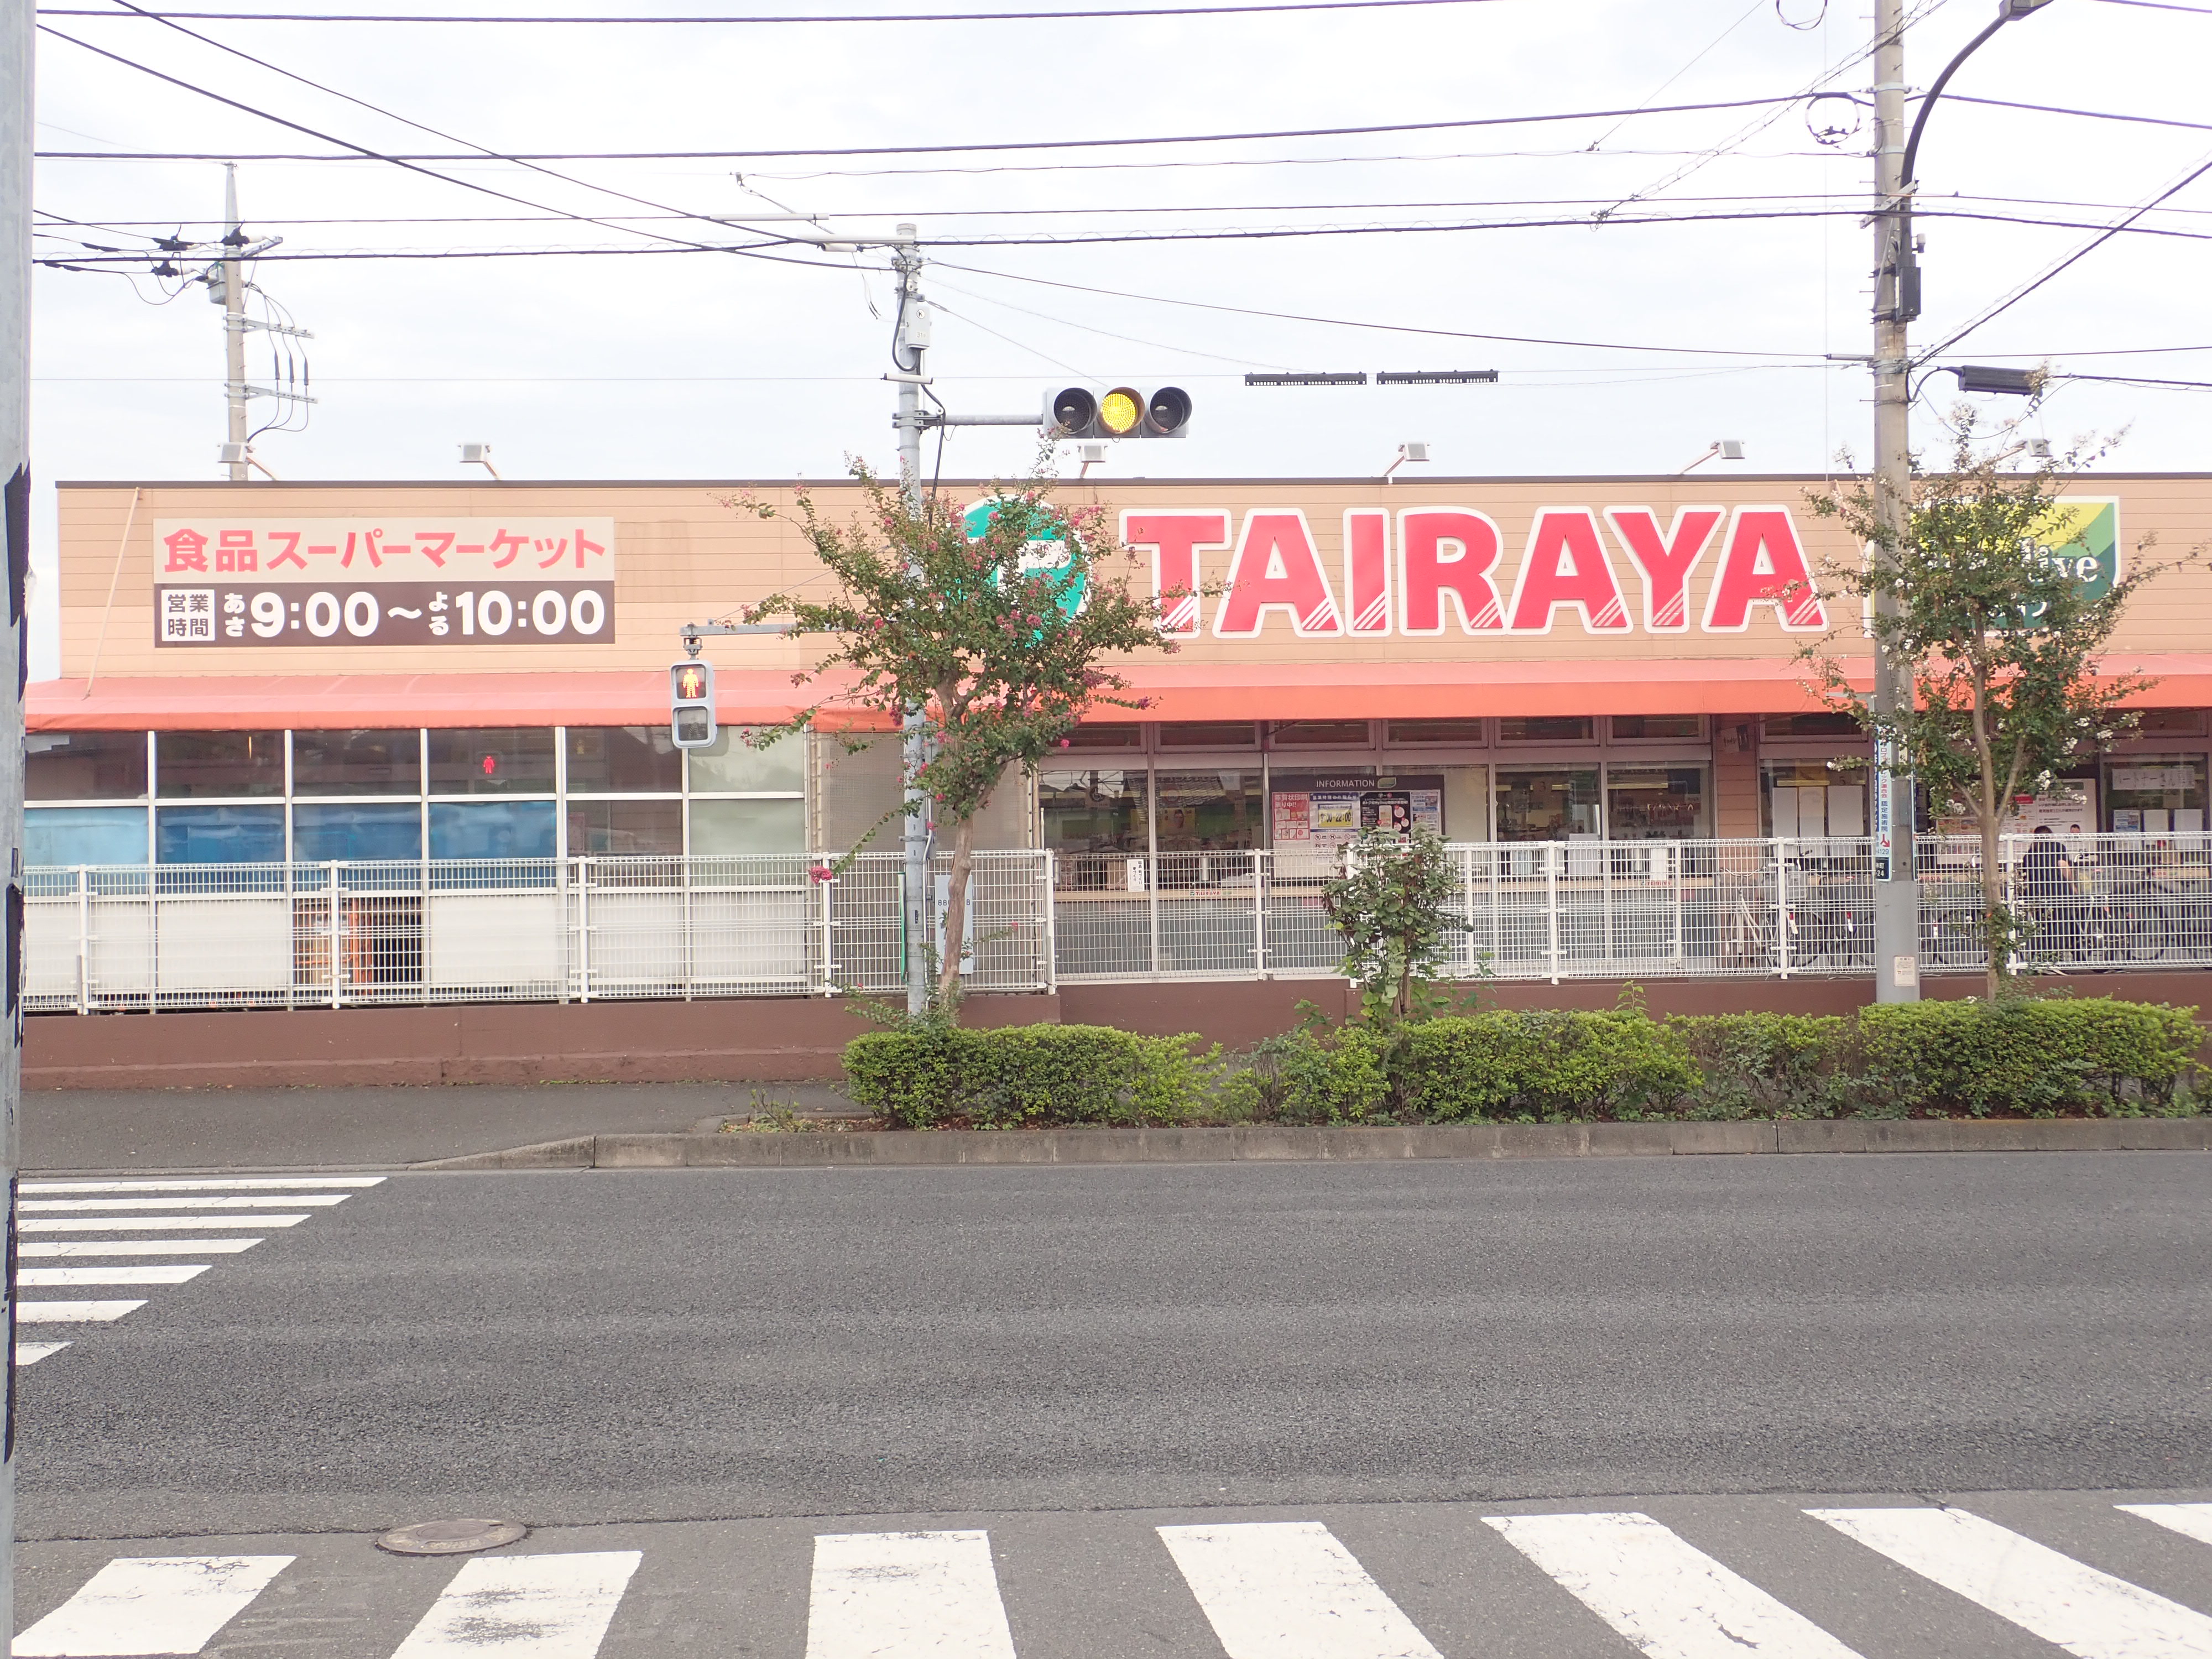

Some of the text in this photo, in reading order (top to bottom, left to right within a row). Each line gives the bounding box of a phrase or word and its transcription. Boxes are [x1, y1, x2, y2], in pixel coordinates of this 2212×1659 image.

[164, 528, 605, 572] 食品スーパーマーケット
[1123, 509, 1825, 635] TAIRAYA
[168, 594, 208, 612] 営業
[224, 593, 245, 637] あさ
[429, 592, 449, 635] よる
[455, 590, 604, 636] 10:00
[168, 618, 208, 637] 時間
